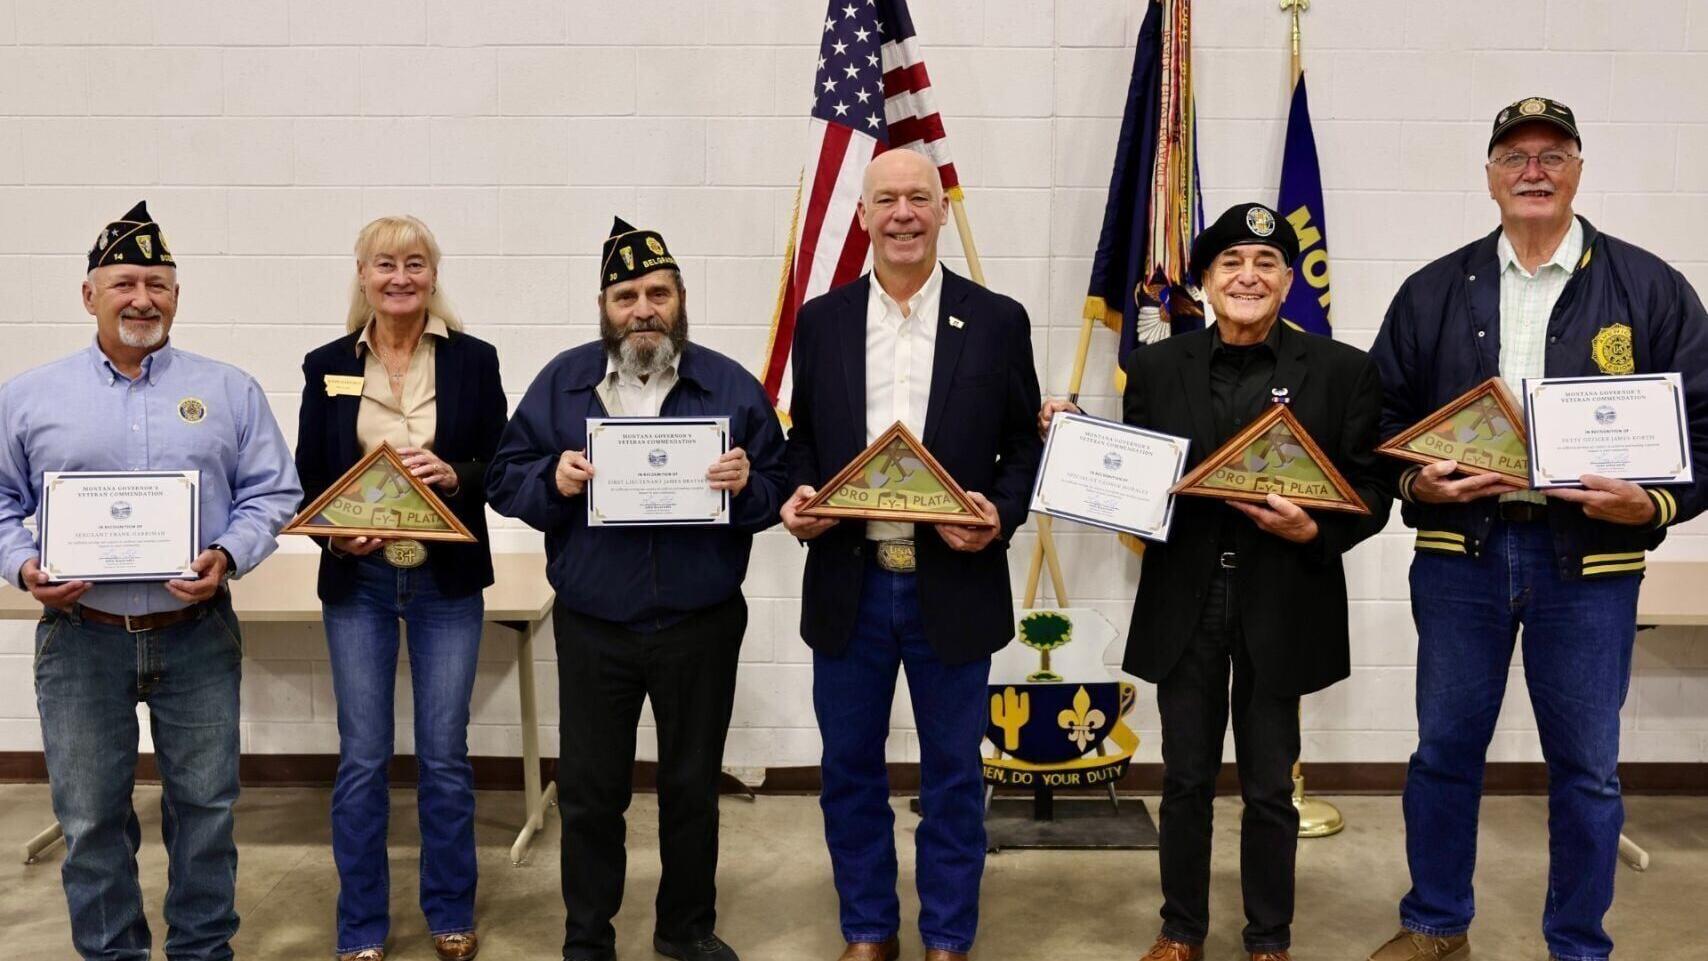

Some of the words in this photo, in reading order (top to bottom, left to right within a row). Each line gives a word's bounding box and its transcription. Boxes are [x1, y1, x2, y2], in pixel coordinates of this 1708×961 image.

[113, 252, 124, 261] 14
[1592, 394, 1647, 402] COMMENDATION
[1079, 435, 1105, 446] VETERAN
[1084, 431, 1113, 442] MONTANA
[1424, 435, 1454, 454] ORO
[1215, 470, 1246, 486] ORO
[1289, 482, 1329, 496] PLATA
[839, 487, 869, 502] ORO
[913, 494, 951, 506] PLATA
[332, 499, 363, 516] ORO
[1012, 771, 1033, 785] DO
[1042, 773, 1080, 786] YOUR
[1086, 764, 1123, 783] DUTY
